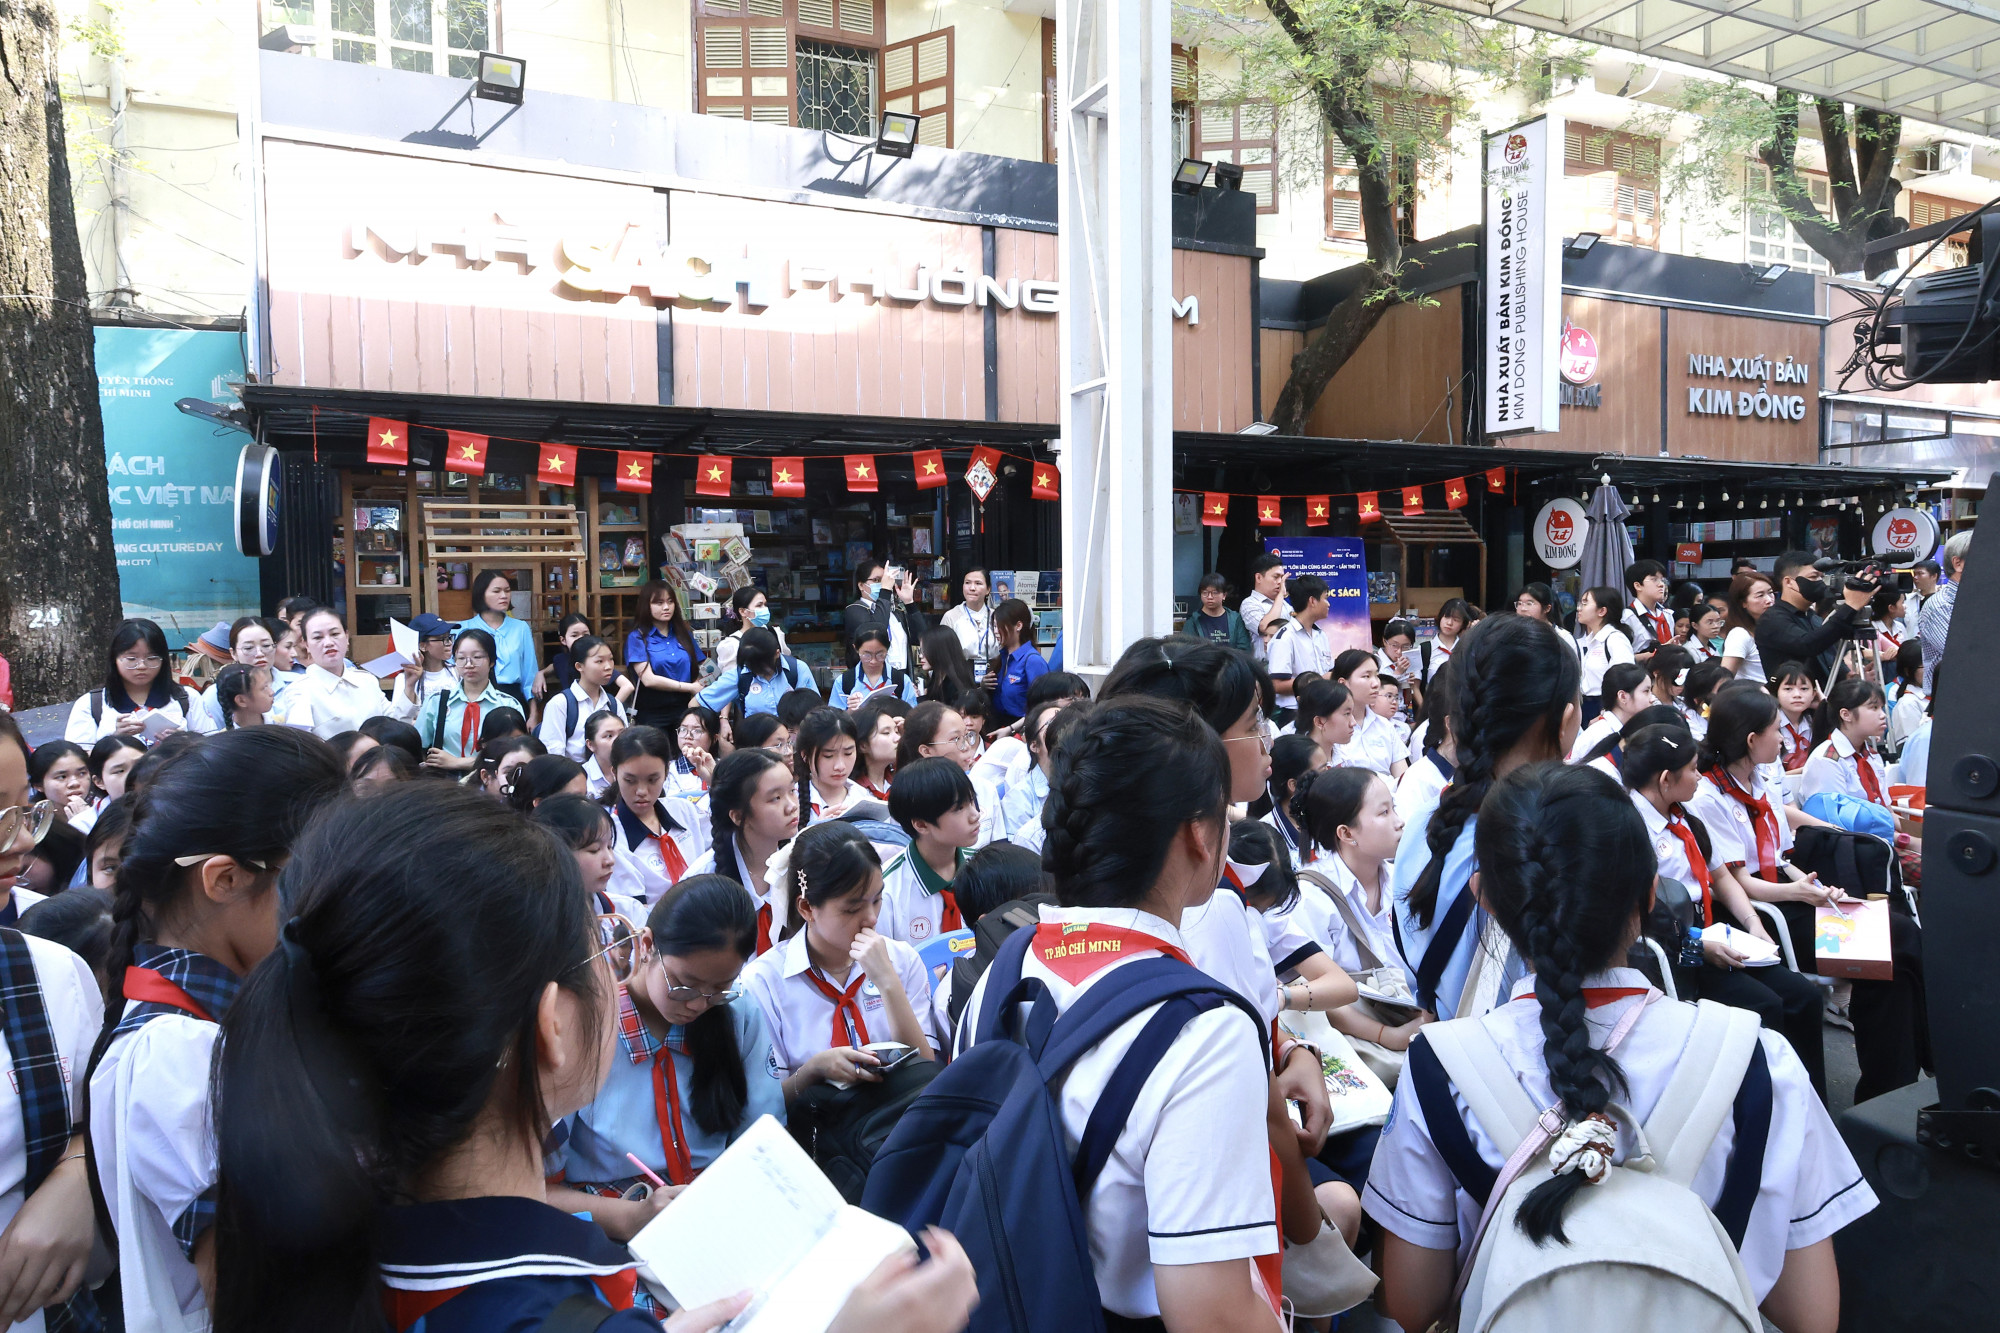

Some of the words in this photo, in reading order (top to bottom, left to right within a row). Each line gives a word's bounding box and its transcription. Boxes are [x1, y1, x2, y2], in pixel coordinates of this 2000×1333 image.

[1516, 189, 1528, 243] HOUSE
[1500, 254, 1511, 288] KIM
[1515, 246, 1527, 334] PUBLISHING
[1496, 293, 1510, 330] BẢN
[1496, 335, 1510, 380] XUẤT
[1514, 337, 1526, 389] DONG
[1729, 353, 1772, 381] XUẤT
[1776, 355, 1809, 384] BẢN
[133, 375, 174, 386] THÔNG
[119, 389, 151, 398] MINH
[1497, 382, 1509, 422] NHÀ
[1689, 387, 1733, 416] KIM
[1738, 382, 1806, 421] ĐỒNG
[1514, 392, 1524, 421] KIM
[107, 451, 165, 475] ÁCH
[134, 482, 196, 507] VIỆT
[201, 485, 235, 505] NA
[150, 519, 174, 529] MINH
[139, 543, 195, 553] CULTURE
[196, 542, 224, 552] DAY
[1544, 543, 1557, 559] KIM
[1681, 549, 1697, 557] -20%
[28, 607, 62, 629] 24
[913, 922, 924, 933] 71
[1068, 939, 1086, 955] CHÍ
[1088, 939, 1122, 954] MINH
